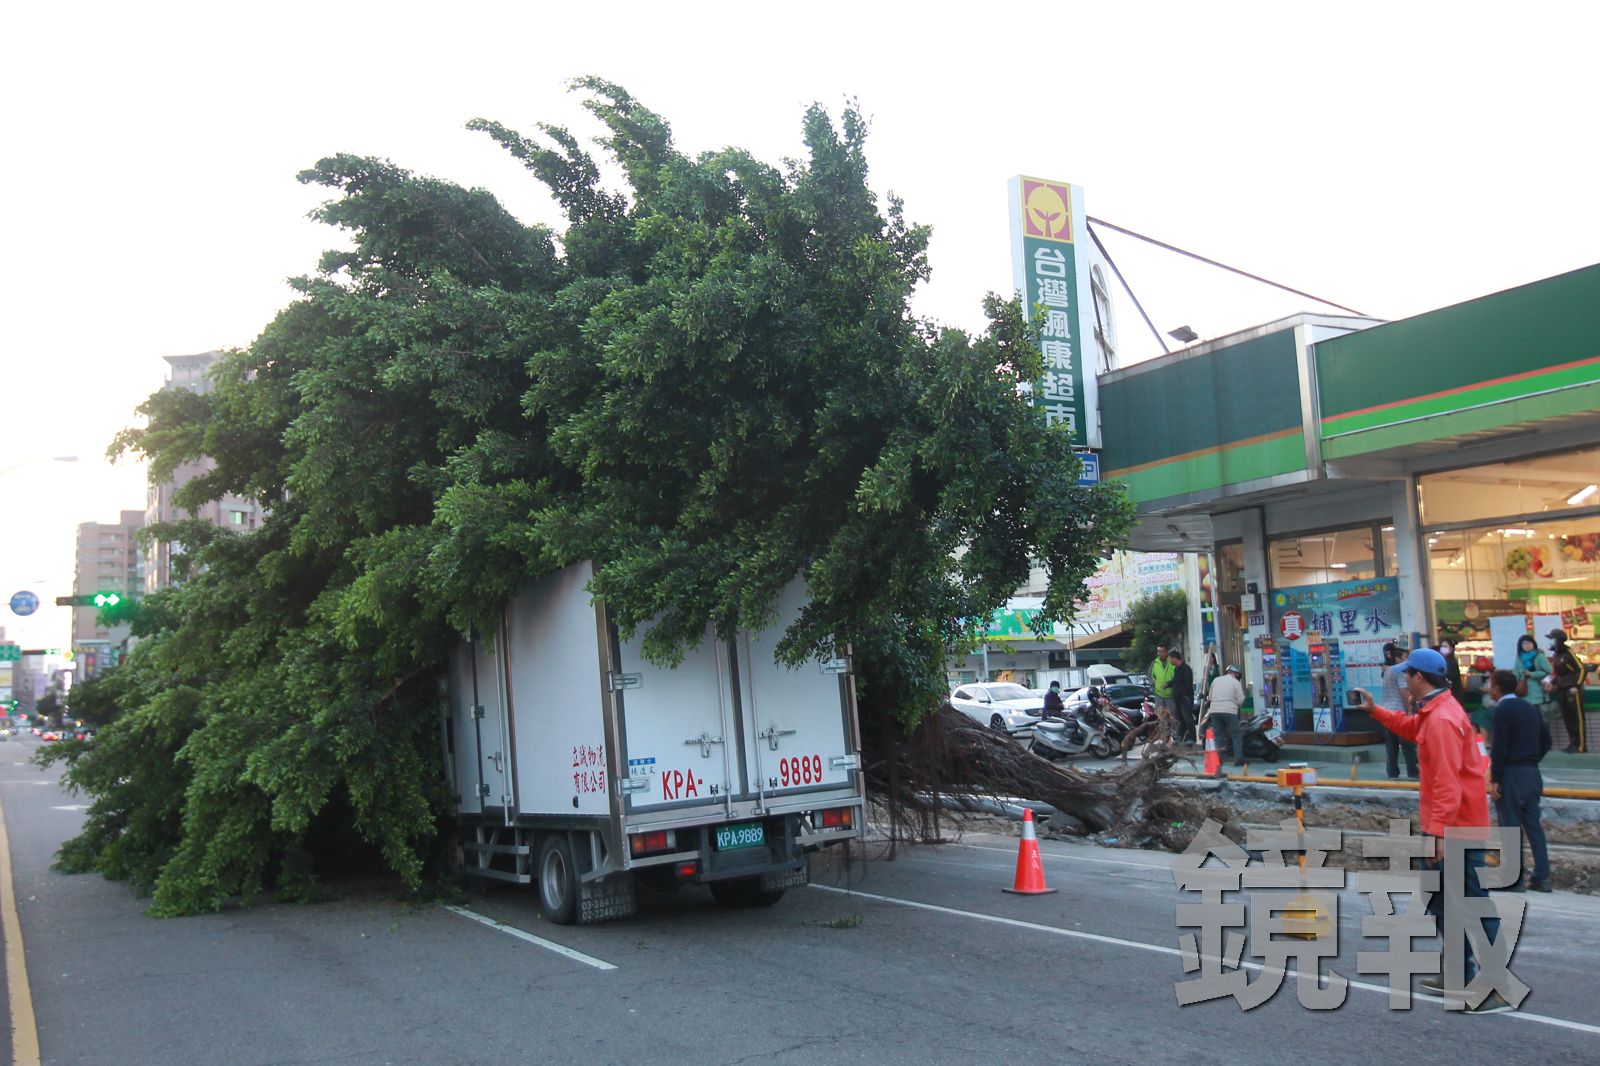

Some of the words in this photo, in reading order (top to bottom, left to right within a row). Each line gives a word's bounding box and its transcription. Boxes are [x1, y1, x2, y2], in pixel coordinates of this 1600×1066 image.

[573, 770, 606, 794] 有限公司
[780, 754, 822, 787] 9889
[717, 828, 763, 848] KPA-9889
